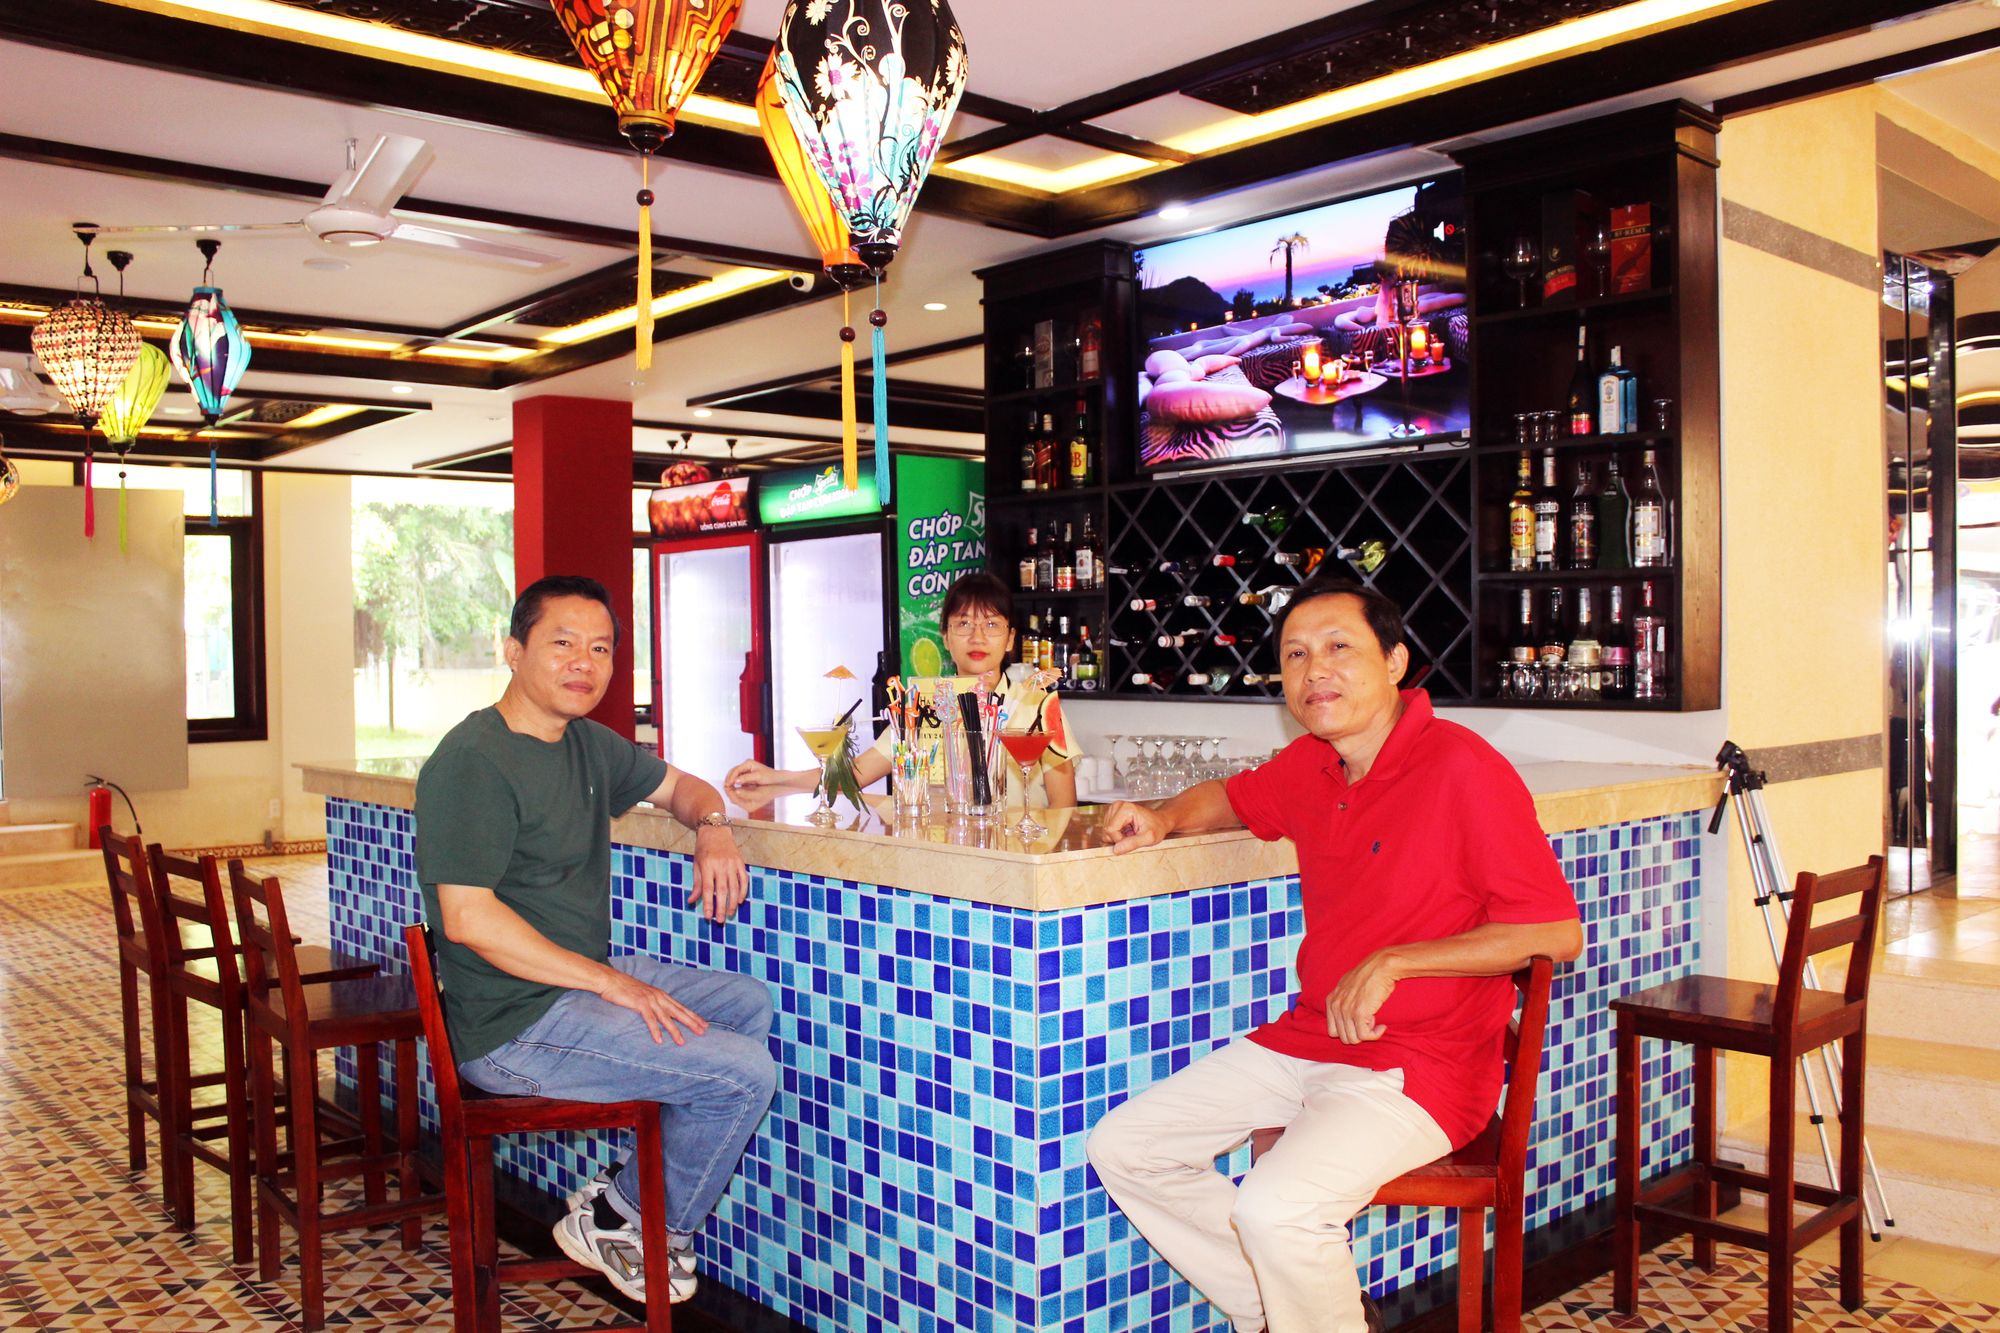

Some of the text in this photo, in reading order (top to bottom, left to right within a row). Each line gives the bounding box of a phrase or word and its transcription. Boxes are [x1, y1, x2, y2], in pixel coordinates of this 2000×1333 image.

[908, 509, 963, 540] CHỚP
[908, 540, 949, 570] ĐẬP
[908, 571, 951, 597] CƠN
